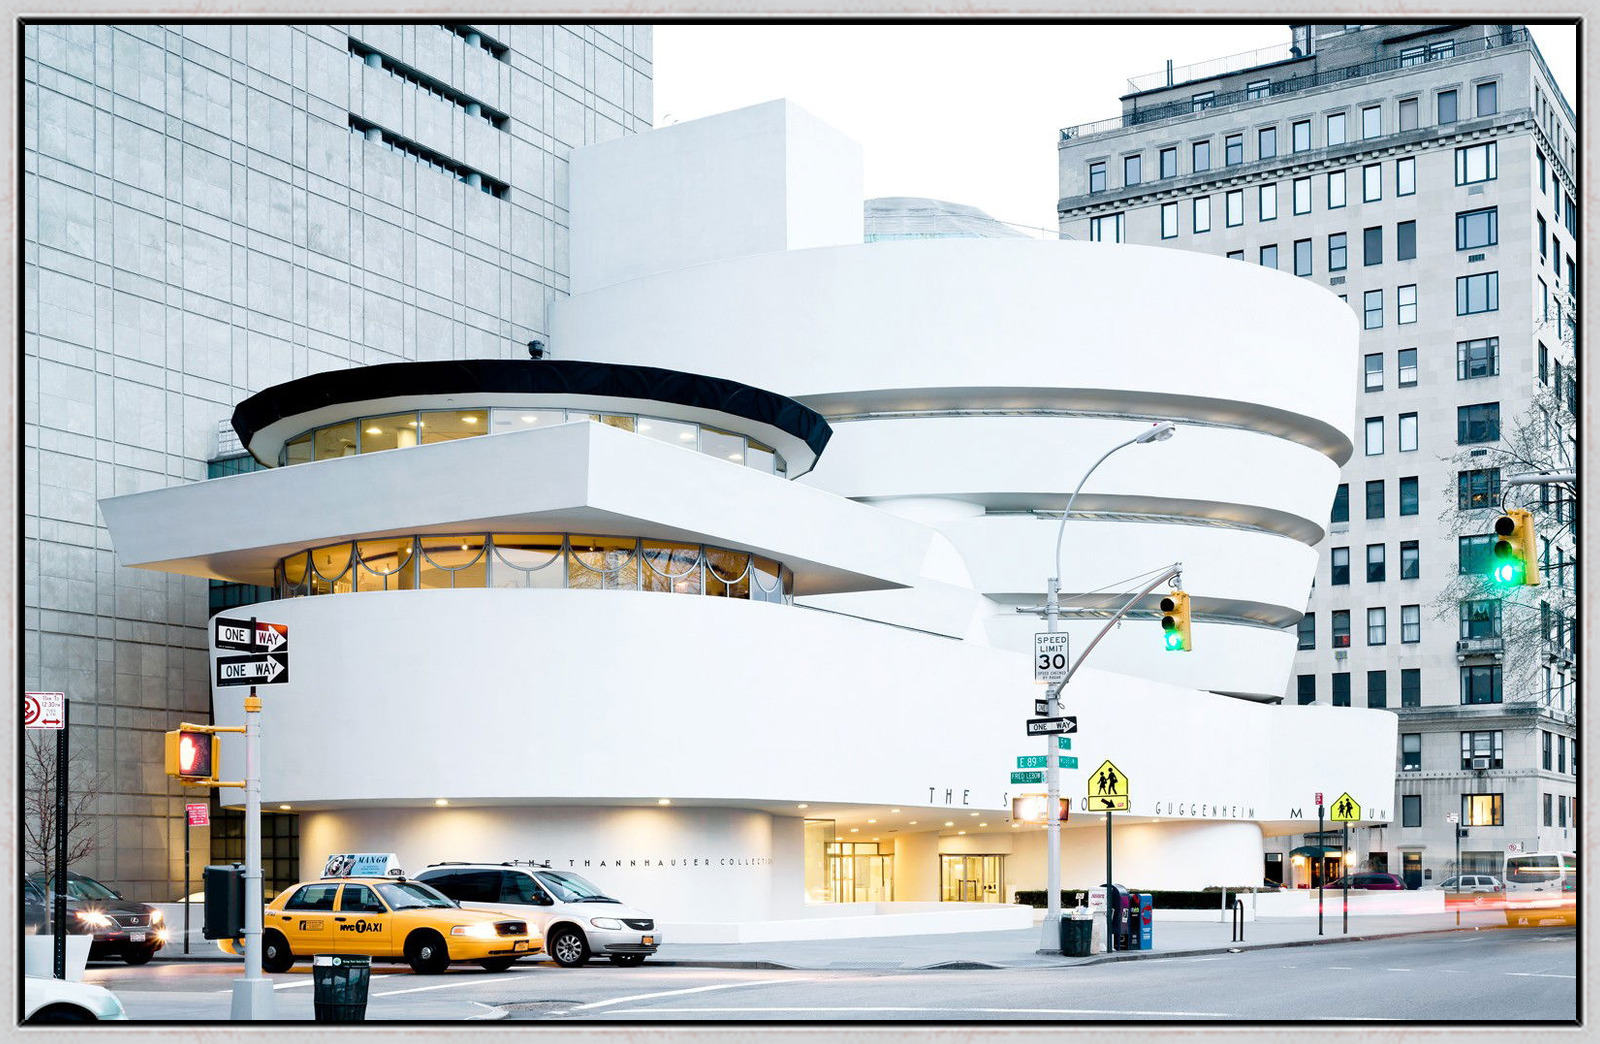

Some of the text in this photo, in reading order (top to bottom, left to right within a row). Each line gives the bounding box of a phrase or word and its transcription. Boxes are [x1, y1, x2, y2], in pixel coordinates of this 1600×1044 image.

[225, 628, 280, 645] ONE WAY
[1037, 636, 1067, 644] SPEED
[1038, 653, 1066, 670] 30
[226, 663, 278, 677] ONE WAY
[1033, 721, 1071, 731] ONE WAY
[1020, 757, 1024, 768] E
[1027, 757, 1037, 768] 89
[929, 787, 970, 806] THE
[1155, 801, 1255, 819] GUGGENHEIM
[1290, 807, 1386, 820] MUM
[358, 856, 388, 864] MANGO
[569, 859, 709, 867] THANNHAUSER
[340, 919, 382, 933] NYC TAXI
